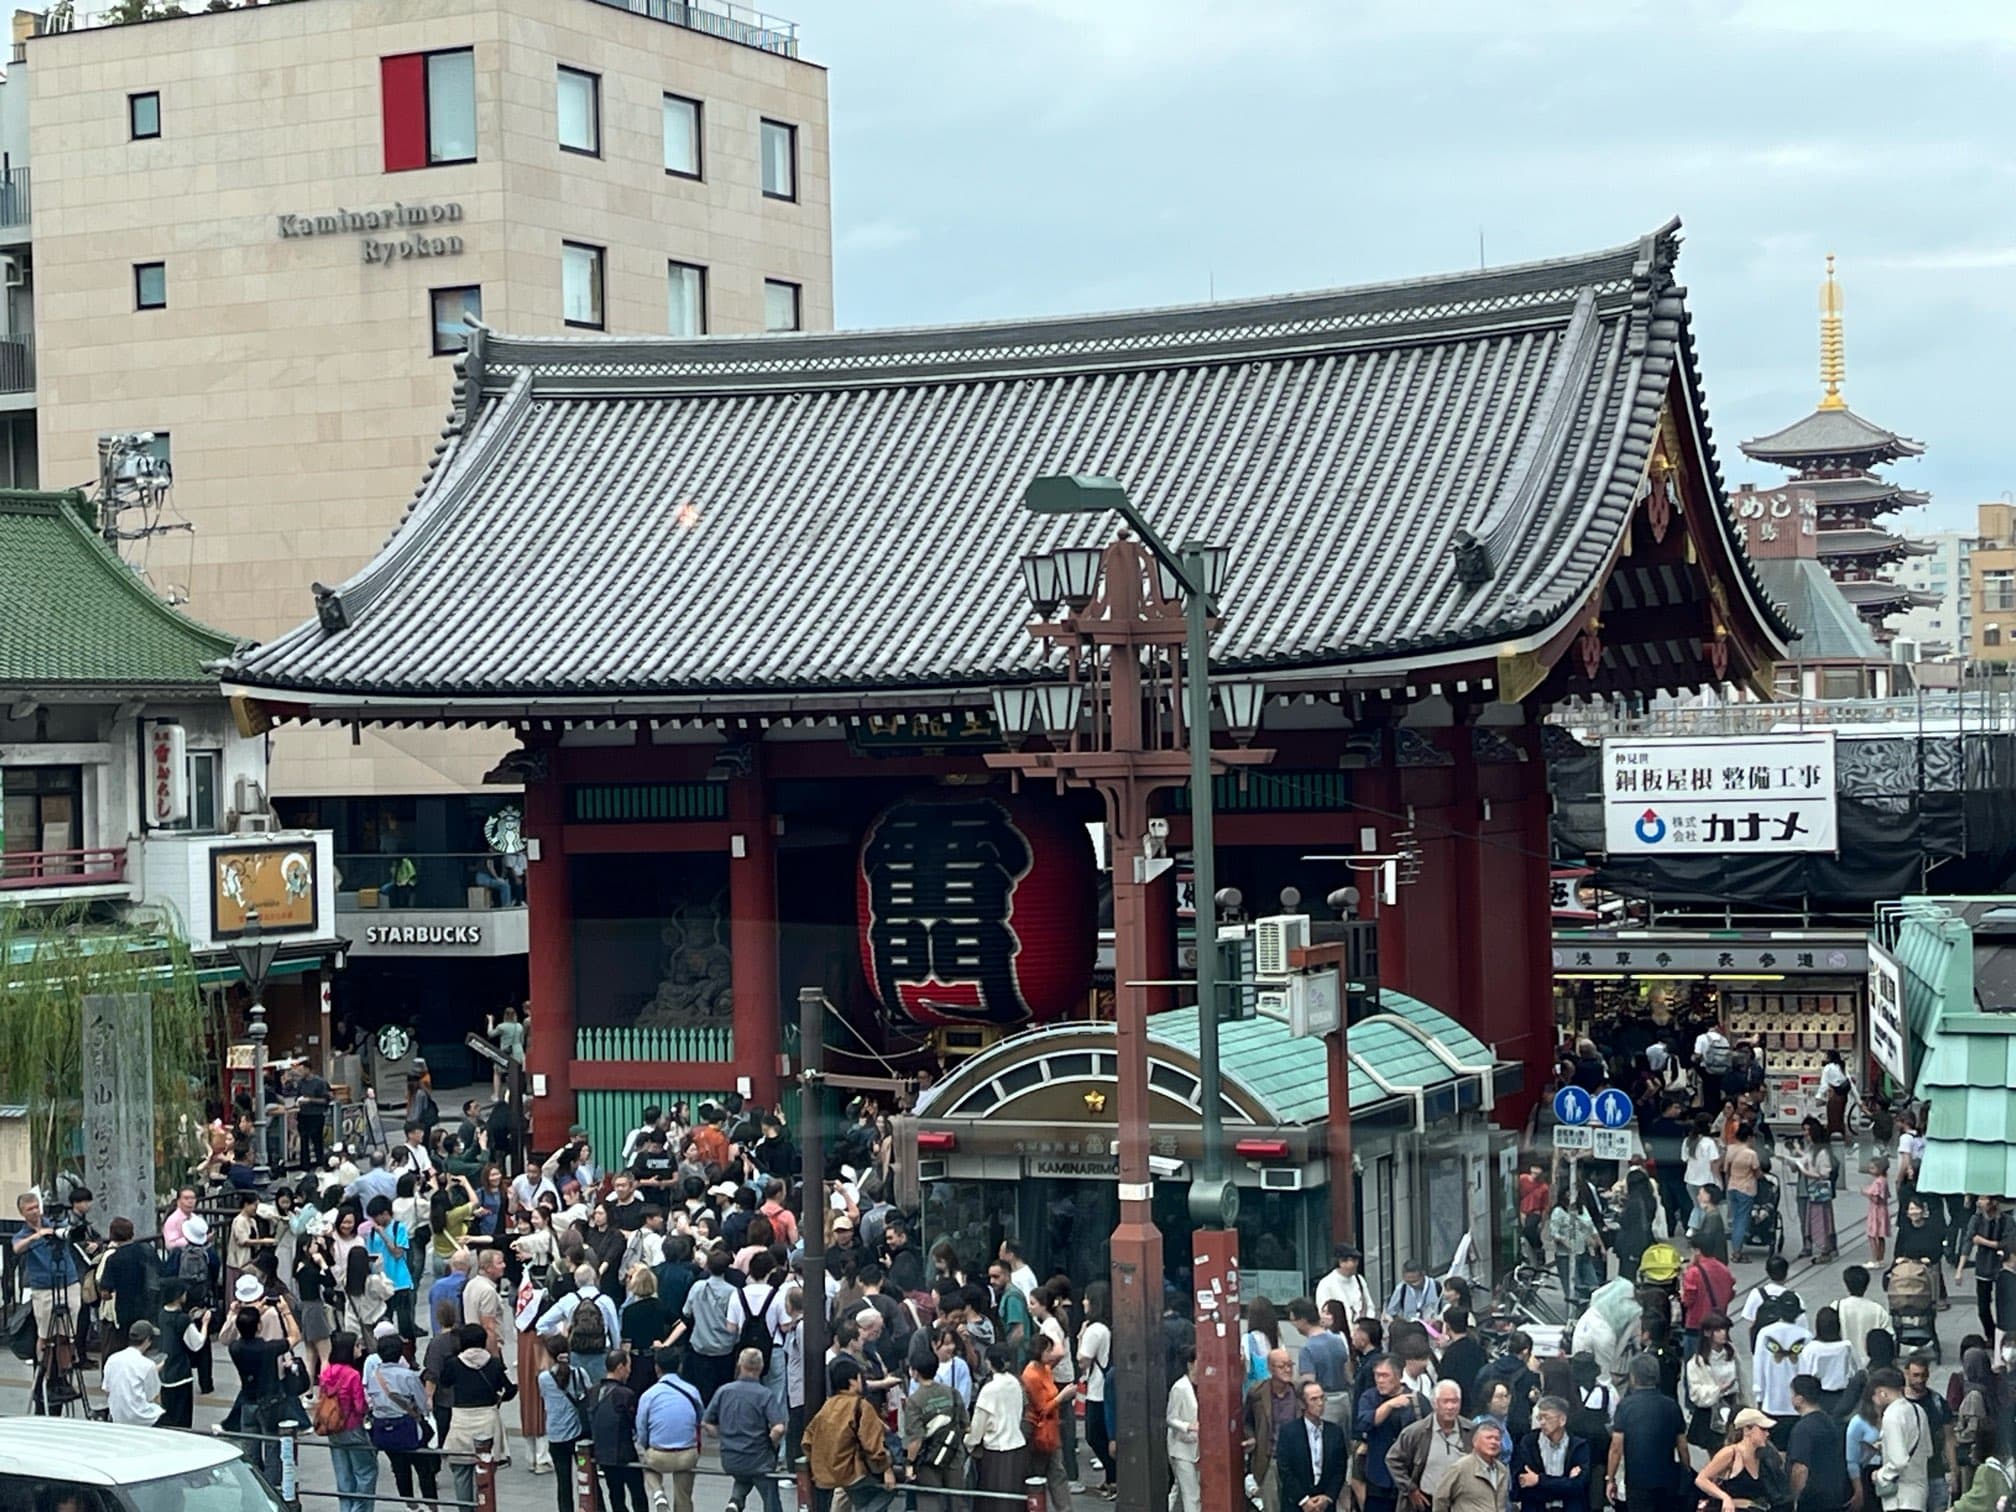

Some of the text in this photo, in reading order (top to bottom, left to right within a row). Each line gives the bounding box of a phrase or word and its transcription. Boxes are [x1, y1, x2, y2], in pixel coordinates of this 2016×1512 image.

[277, 201, 463, 239] Kaminarimon
[362, 232, 464, 268] Ryokan
[1721, 765, 1822, 790] 整備工事
[1672, 816, 1698, 828] 株式
[1701, 811, 1809, 843] カナメ
[1672, 830, 1698, 843] 会社
[862, 798, 1035, 1026] 雷門
[366, 925, 482, 944] STARBUCKS
[1575, 951, 1815, 969] 浅草寺 表参道
